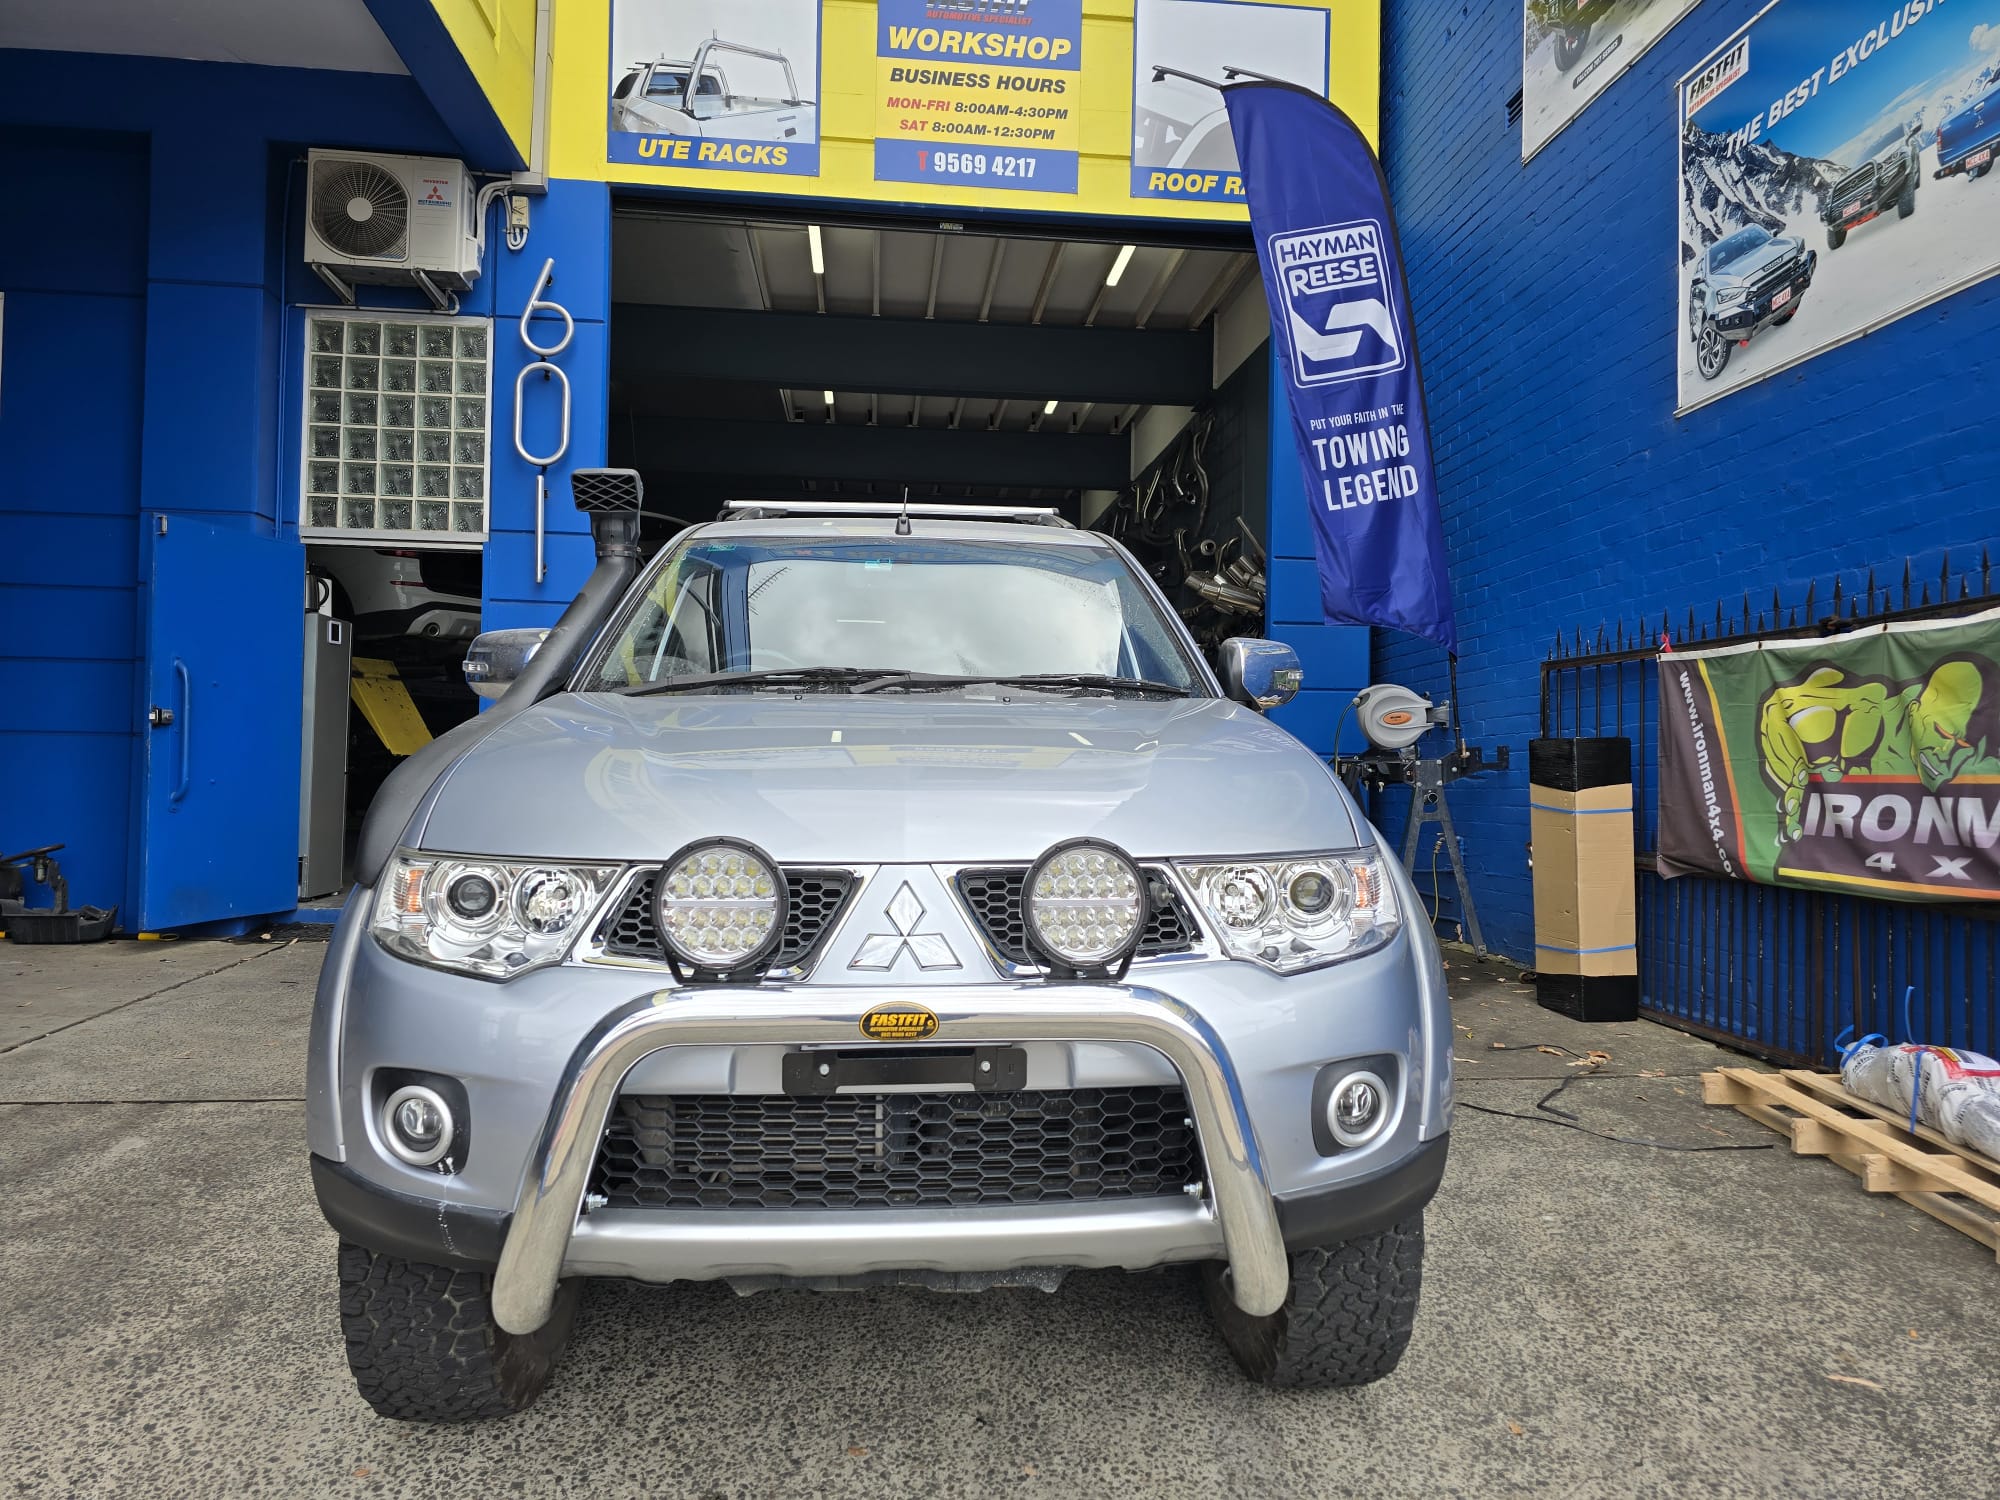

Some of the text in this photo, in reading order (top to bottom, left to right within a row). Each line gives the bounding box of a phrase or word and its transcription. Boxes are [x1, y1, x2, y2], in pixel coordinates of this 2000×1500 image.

[888, 26, 1072, 61] WORKSHOP
[890, 67, 1066, 94] BUSINESS HOURS
[1689, 41, 1746, 102] FASTFIT
[1727, 0, 1945, 158] THE BEST EXCLUSI
[886, 96, 1069, 120] MON-FRI 8:00AM-4:30PM
[900, 119, 1055, 140] SAT 8:00AM-12:30PM
[638, 138, 788, 166] UTE RACKS
[917, 151, 1036, 178] T 9569 4217
[1148, 172, 1246, 195] ROOF R
[1279, 230, 1375, 263] HAYMAN
[1288, 256, 1378, 297] REESE
[1310, 403, 1404, 430] PUT YOUR FAITH IN THE
[1312, 424, 1410, 471] TOWING
[1323, 465, 1419, 511] LEGEND
[1864, 851, 1974, 881] 4 X
[870, 1013, 928, 1026] FASTFIT
